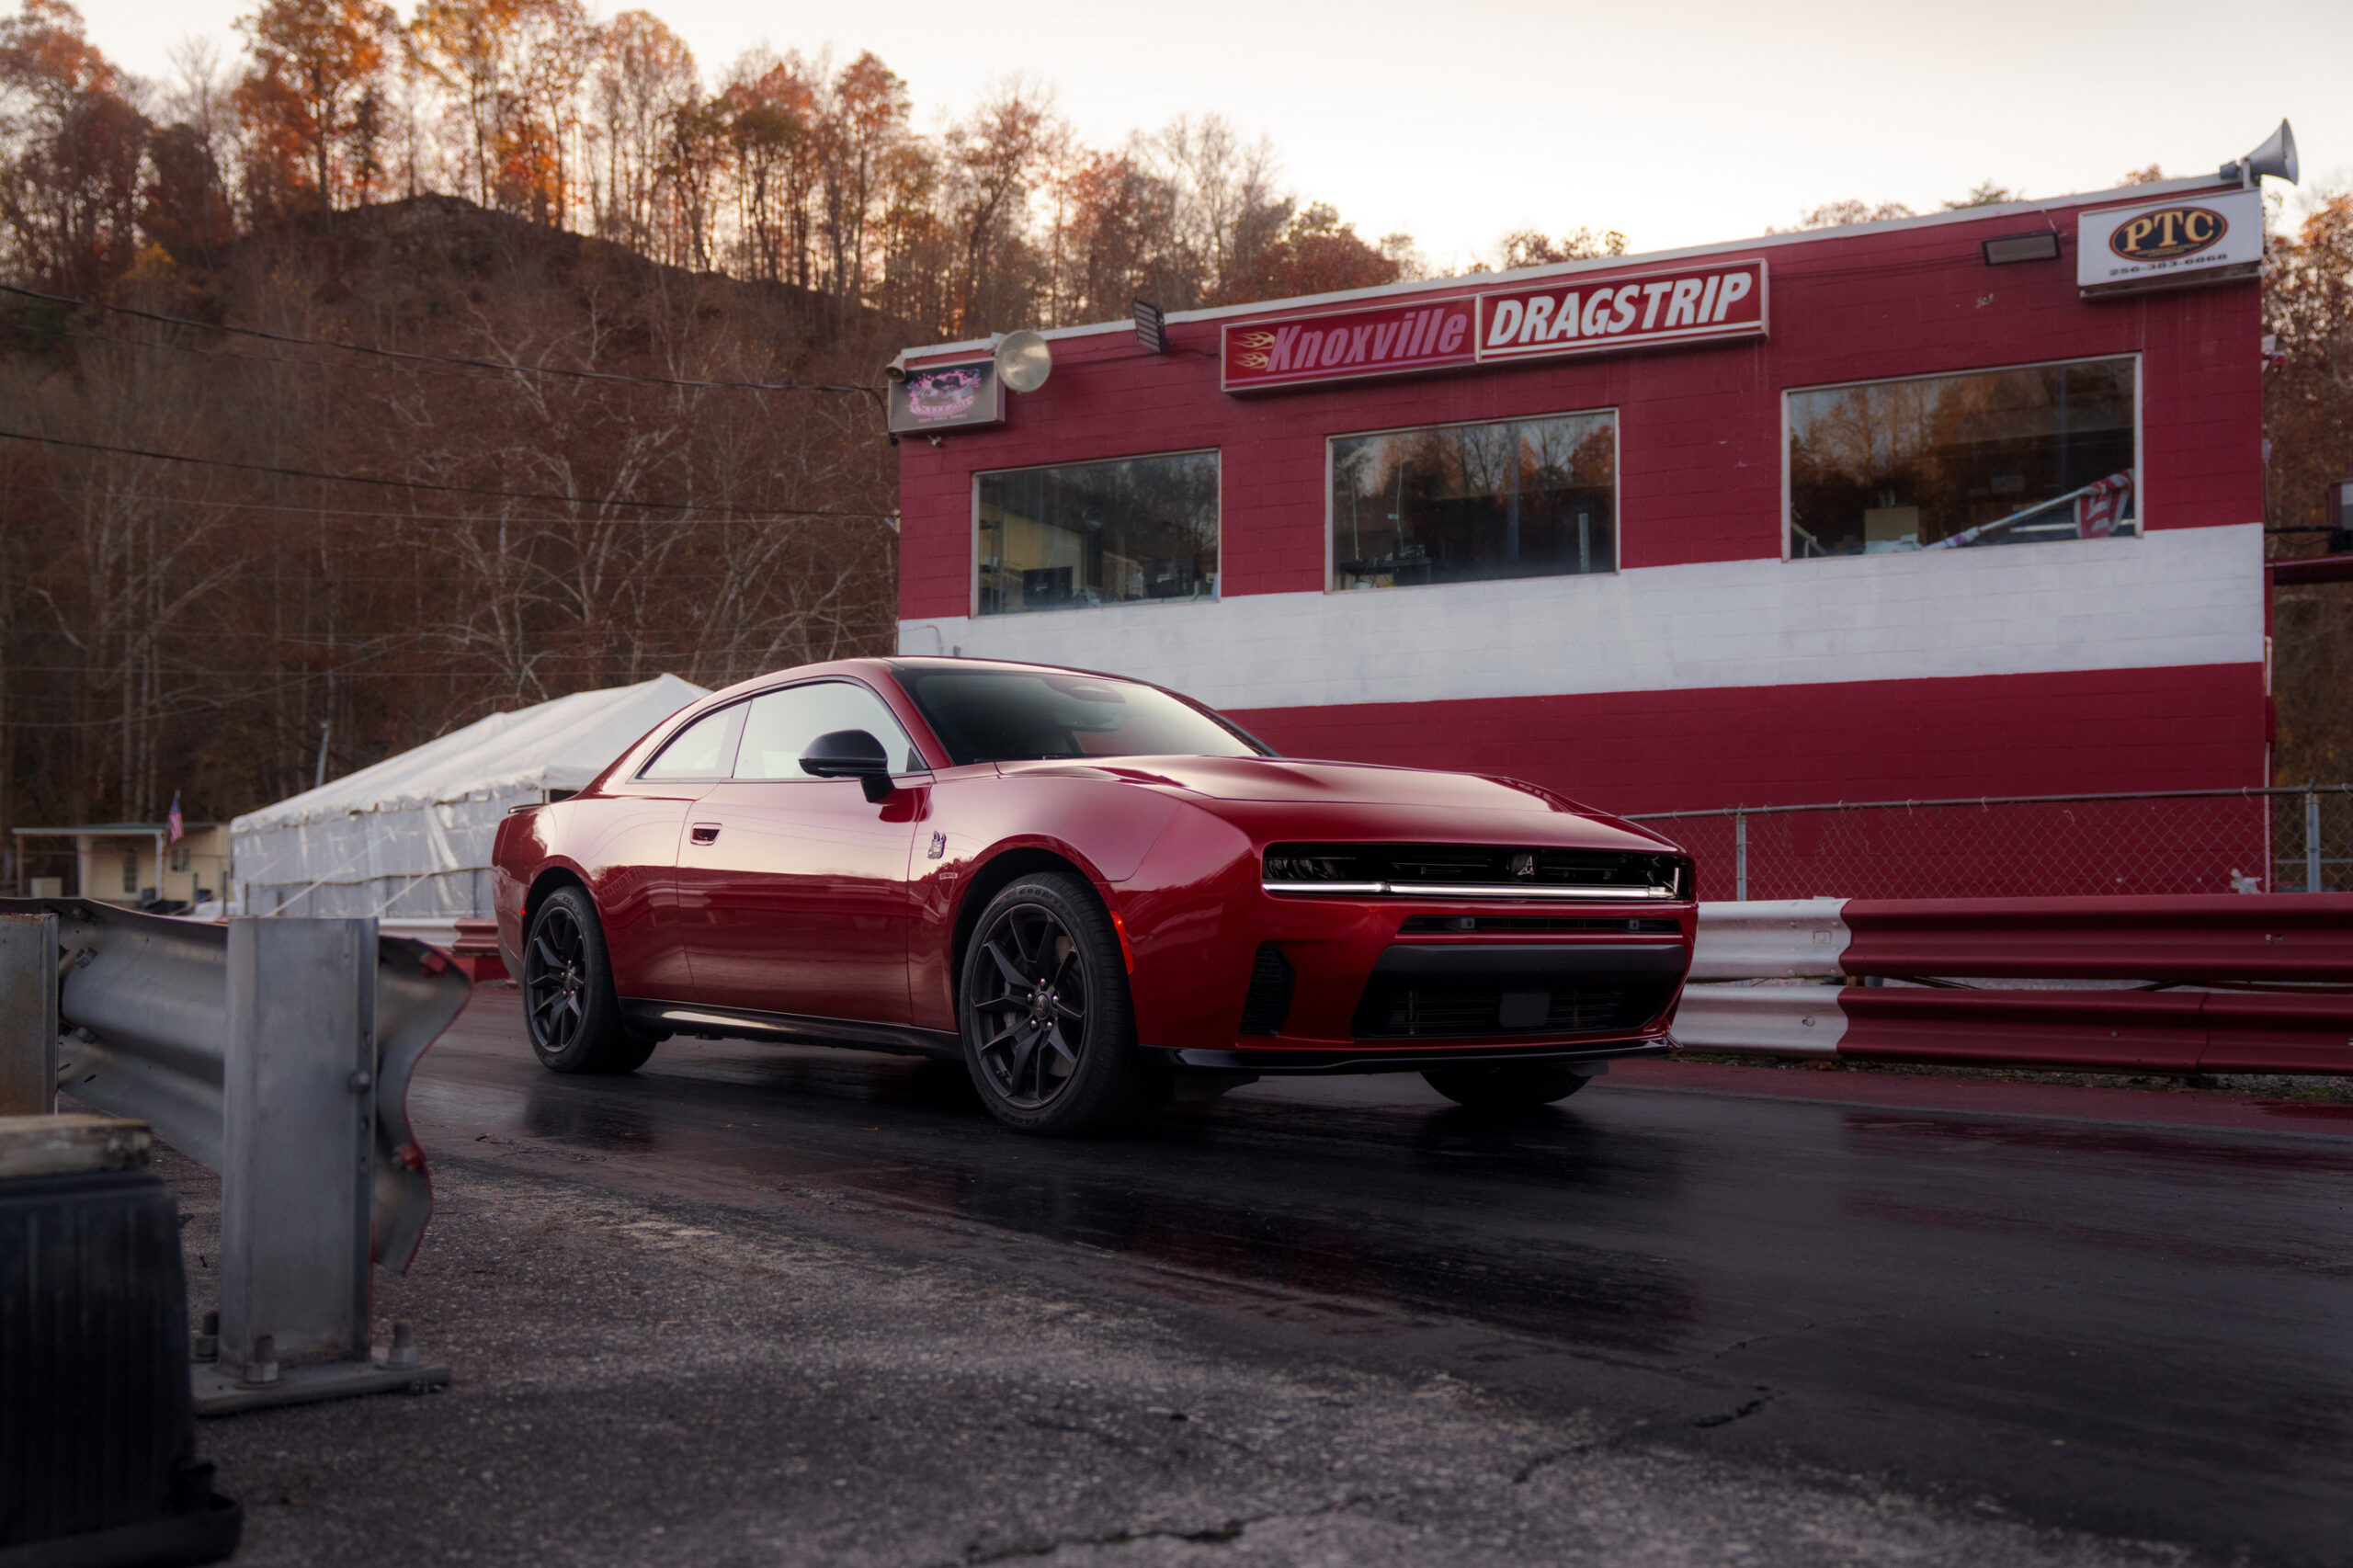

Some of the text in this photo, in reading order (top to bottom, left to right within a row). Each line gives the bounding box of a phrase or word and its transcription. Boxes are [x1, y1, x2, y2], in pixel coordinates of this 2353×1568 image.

[2124, 211, 2213, 252] PTC
[1266, 271, 1753, 372] Knoxville DRAGSTRIP
